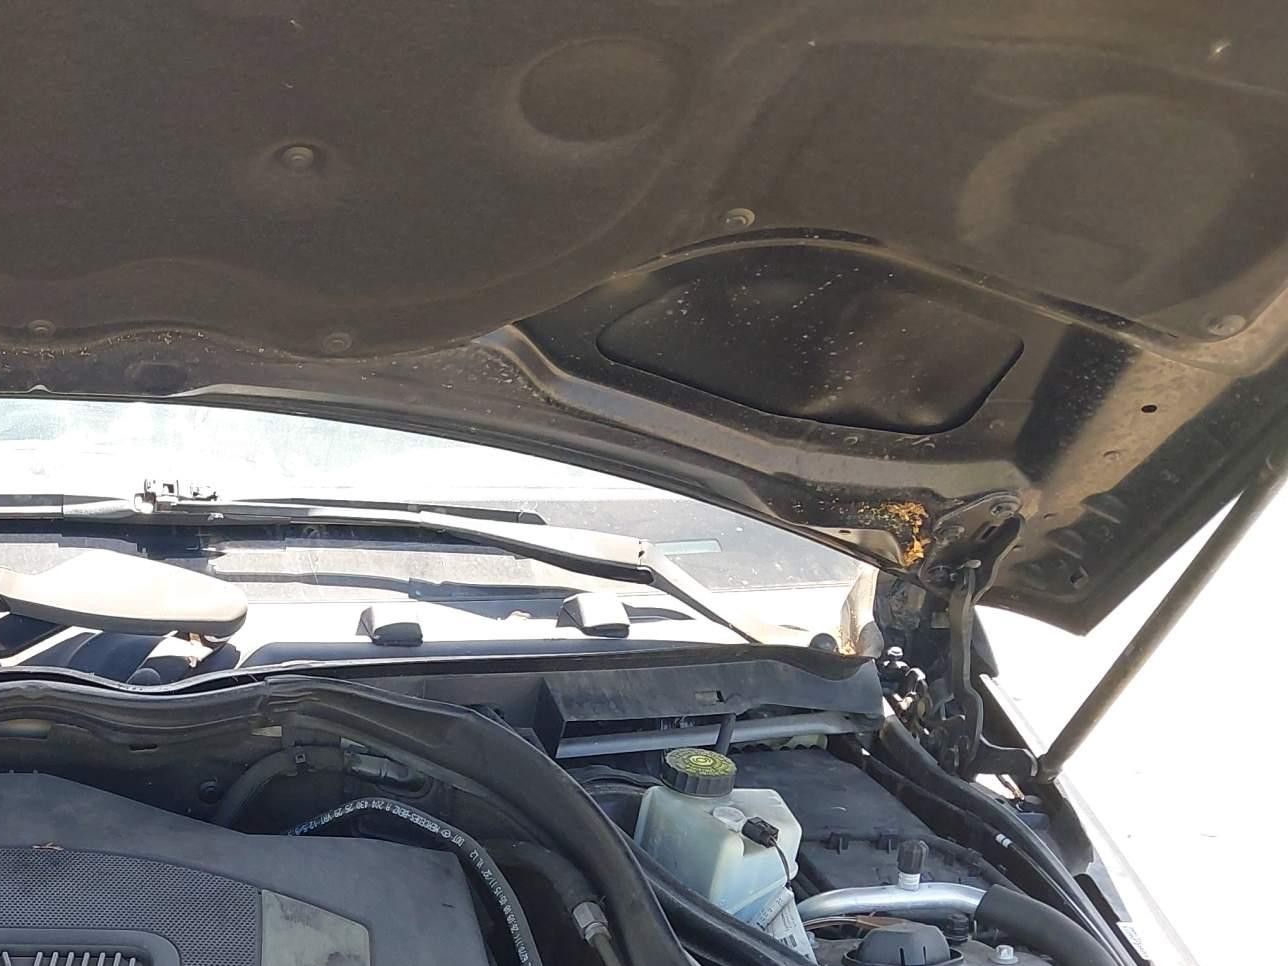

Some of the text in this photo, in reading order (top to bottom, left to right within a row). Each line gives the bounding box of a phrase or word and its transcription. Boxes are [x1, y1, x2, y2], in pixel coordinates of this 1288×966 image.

[355, 800, 369, 809] 430
[371, 800, 384, 810] 204
[392, 804, 440, 833] MERCEDES-BENZ
